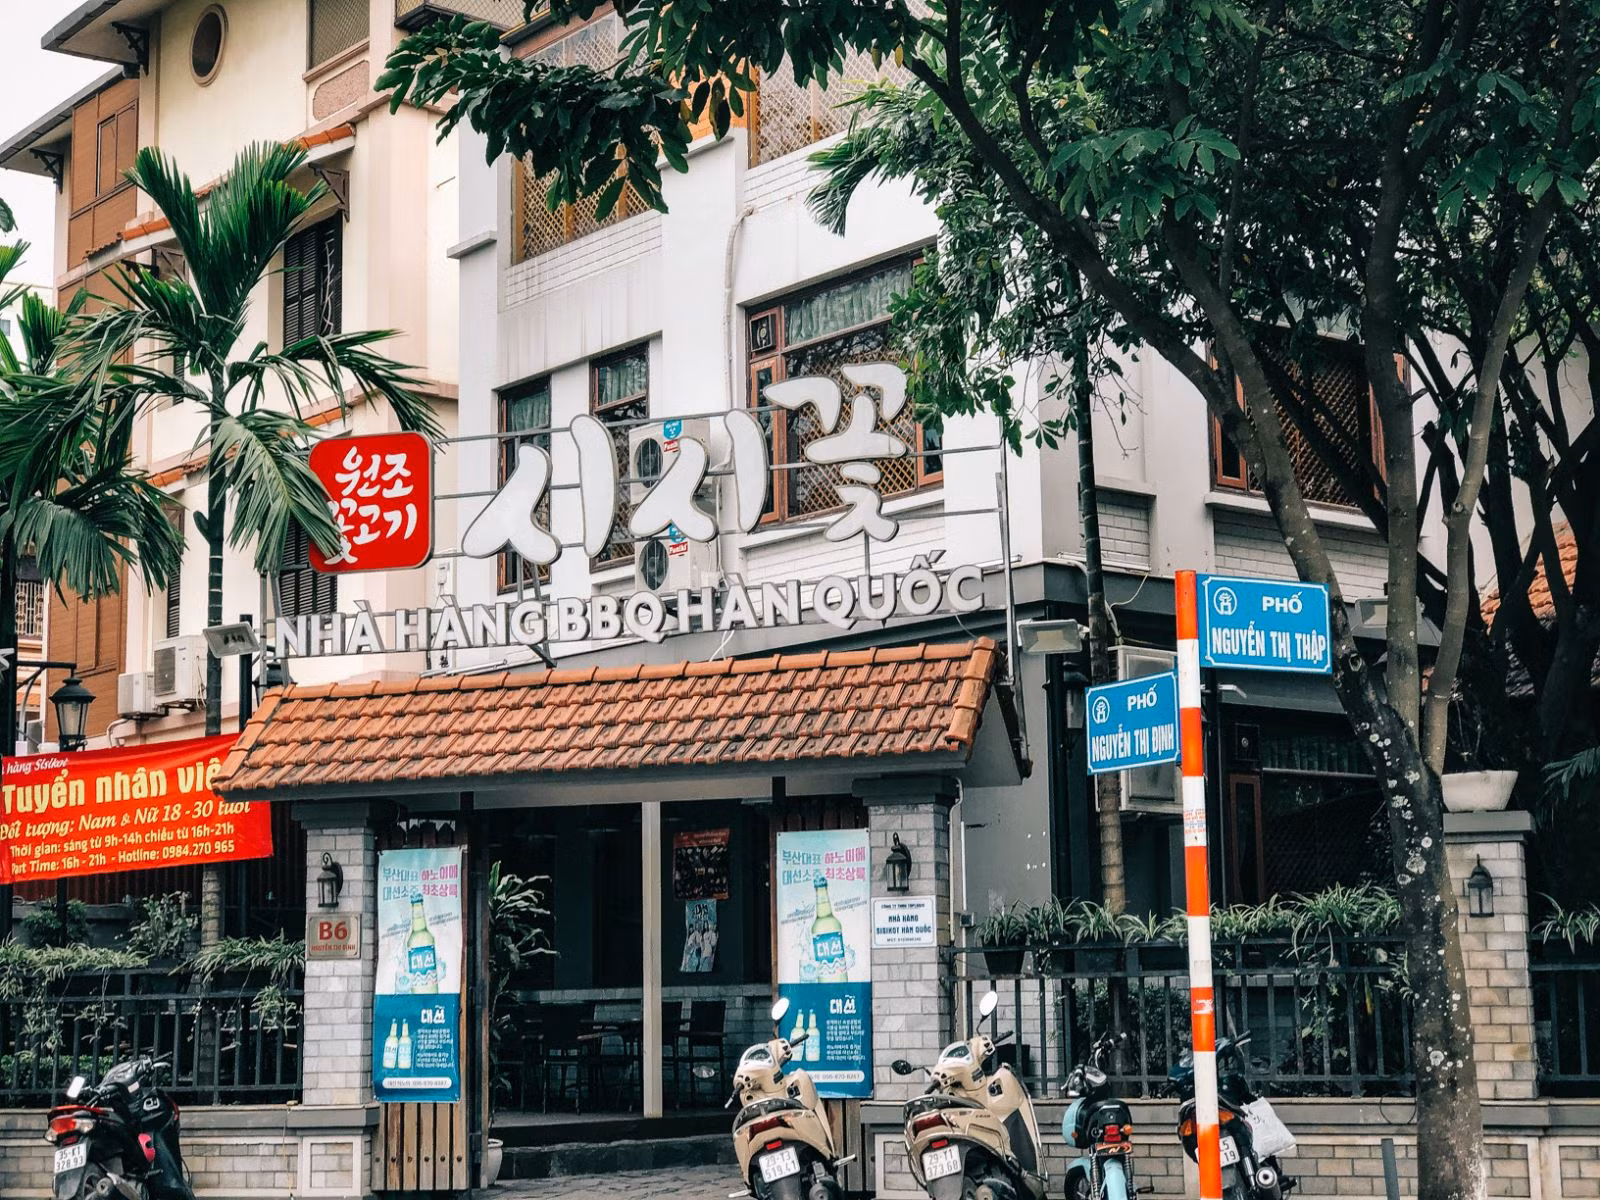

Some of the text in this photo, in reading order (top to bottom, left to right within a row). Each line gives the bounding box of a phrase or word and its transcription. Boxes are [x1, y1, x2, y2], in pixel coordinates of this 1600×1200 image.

[335, 445, 414, 498] 원조
[462, 361, 908, 566] 시시꽃
[275, 549, 985, 658] NHÀ HÀNG BBQ HÀN QUỐC
[1262, 591, 1303, 614] PHỐ
[1211, 620, 1326, 664] NGUYỄN THỊ THẬP
[1127, 683, 1158, 712] PHỐ
[1091, 723, 1174, 762] NGUYỄN THỊ ĐỊNH
[7, 761, 32, 775] hàng
[2, 769, 85, 814] Tuyển
[95, 767, 167, 803] nhân
[25, 820, 75, 839] tượng:
[78, 813, 117, 831] Nam
[120, 813, 130, 826] &
[134, 806, 159, 825] Nữ
[162, 803, 182, 822] 18
[10, 822, 234, 858] Thời gian: sáng từ 9h-14h chiều từ 16h-21h
[12, 862, 26, 875] Part
[29, 859, 60, 873] Time:
[61, 856, 80, 869] 16h
[88, 853, 107, 867] 21h
[118, 848, 160, 863] Hotline:
[162, 842, 212, 859] 0984.270
[214, 840, 235, 852] 965
[320, 921, 348, 940] B6
[888, 914, 918, 922] NHÀ HÀNG
